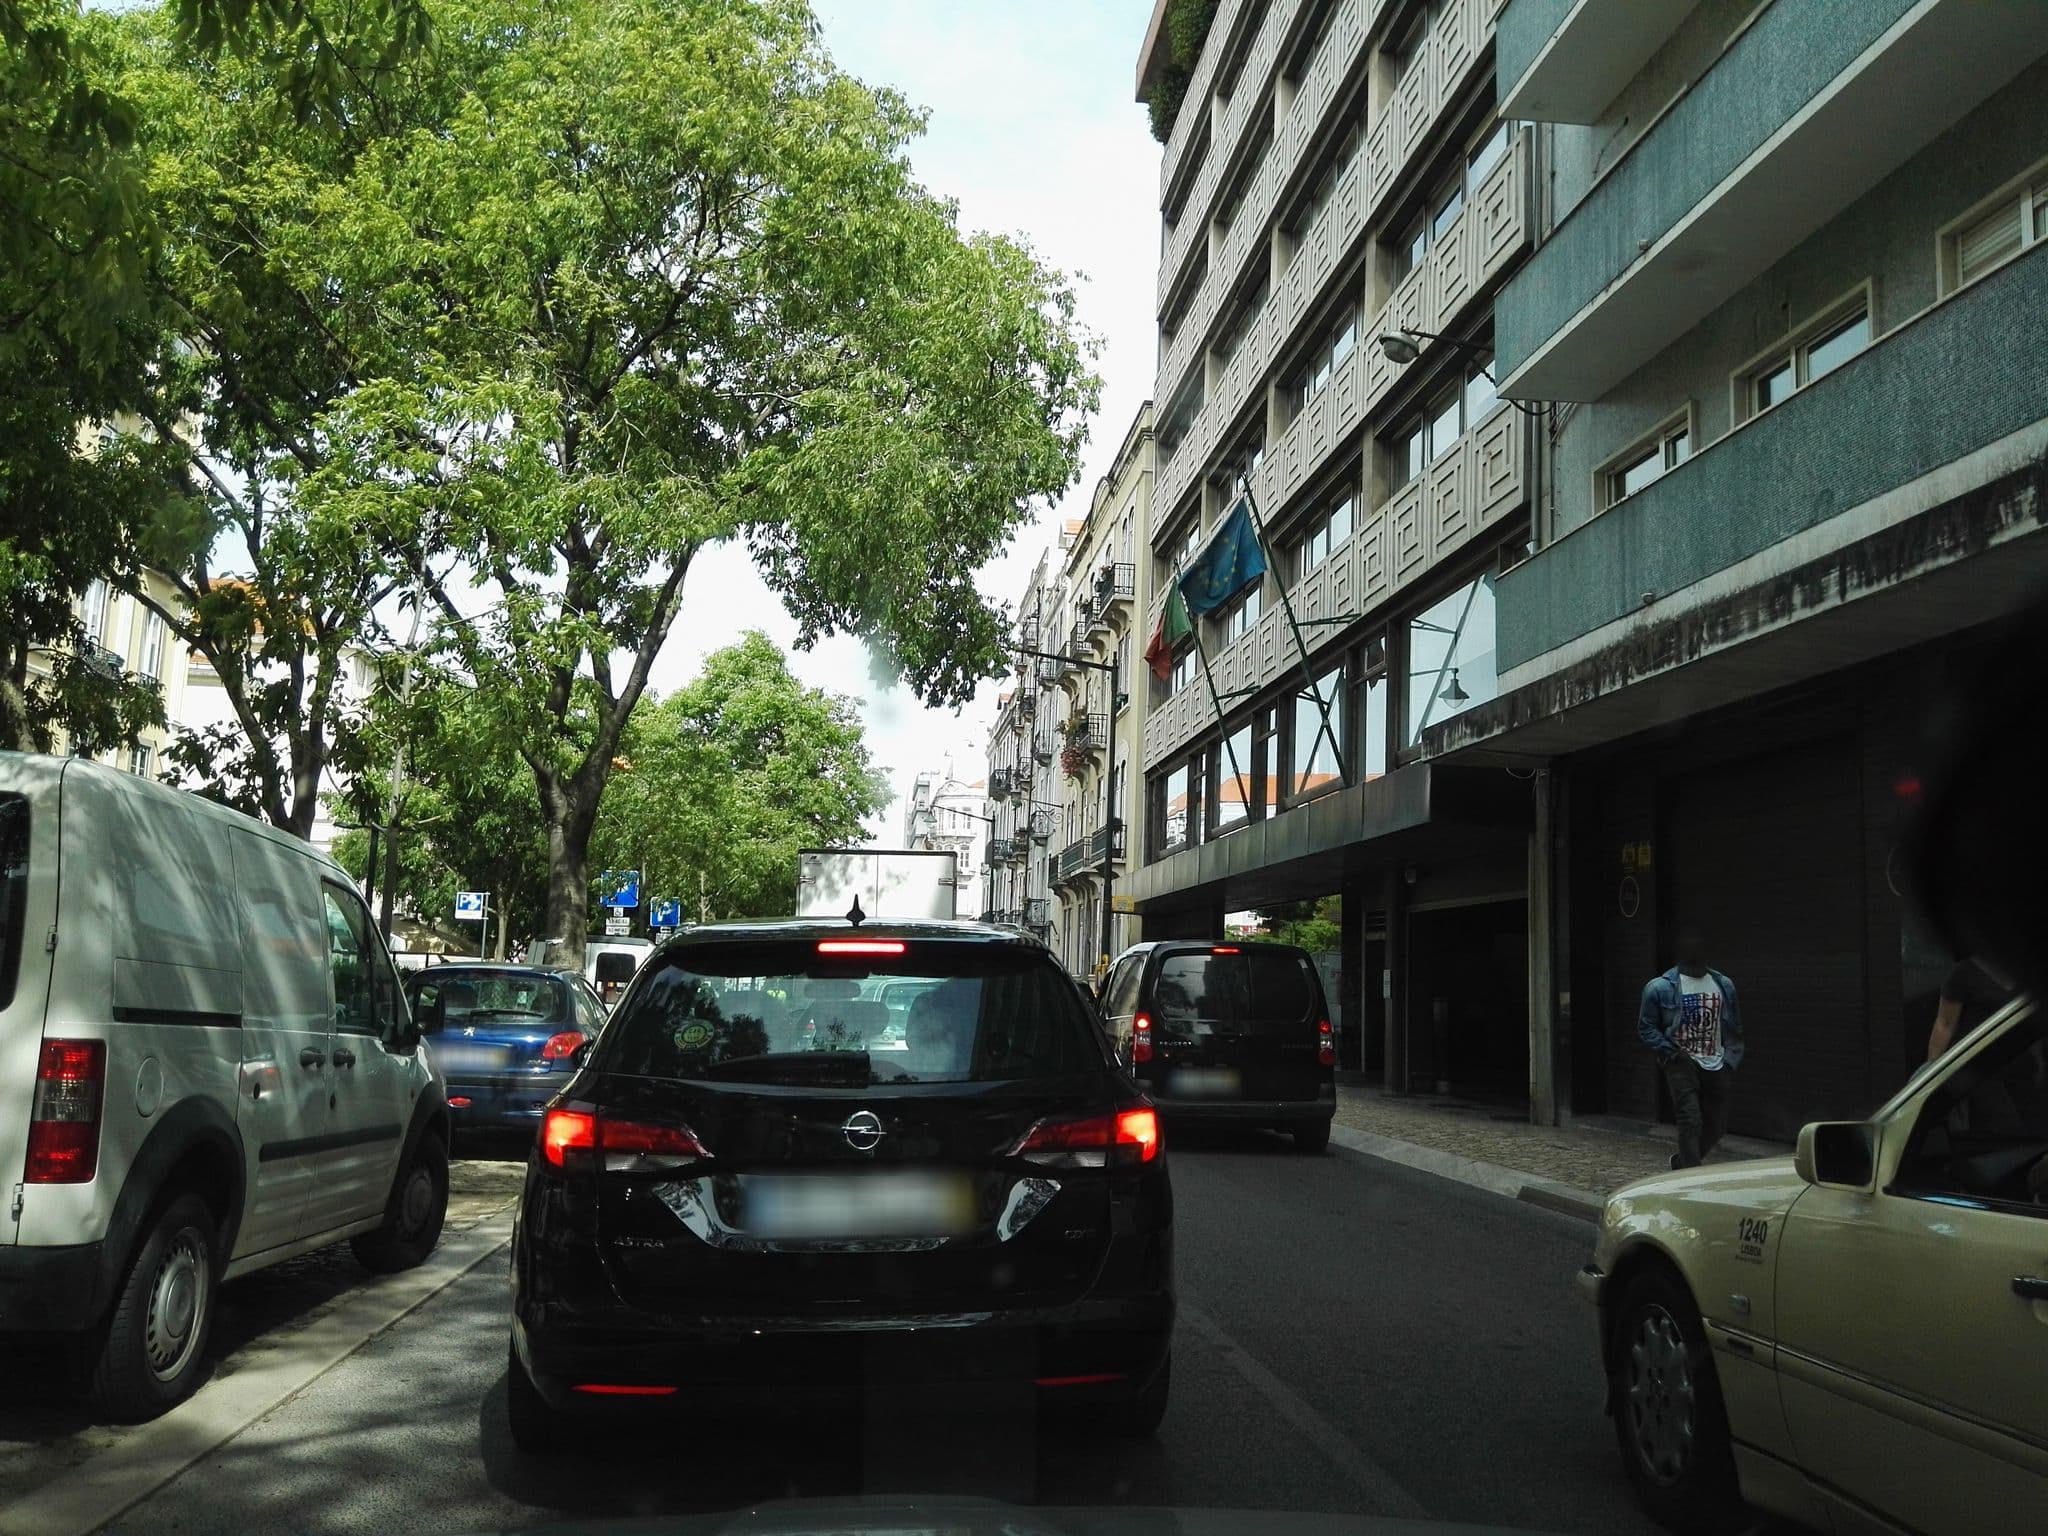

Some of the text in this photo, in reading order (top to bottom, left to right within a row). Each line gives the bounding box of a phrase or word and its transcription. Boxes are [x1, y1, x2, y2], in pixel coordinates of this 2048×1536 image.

[459, 894, 469, 908] P
[657, 901, 672, 922] P
[1739, 1217, 1768, 1244] 1240
[1740, 1244, 1762, 1257] LISBOA
